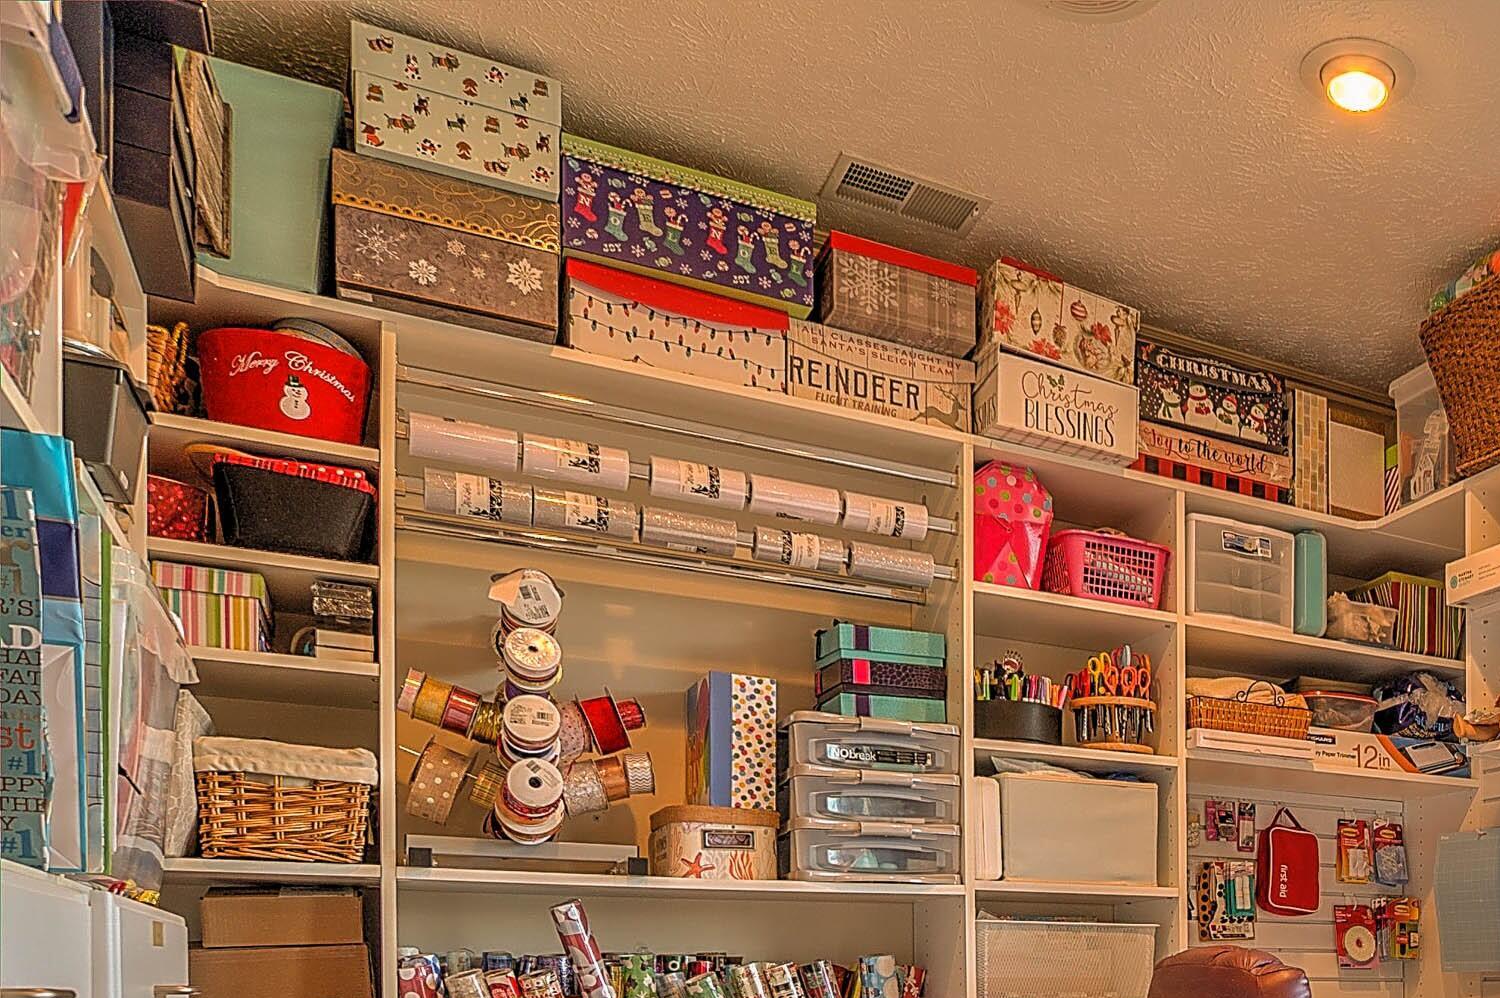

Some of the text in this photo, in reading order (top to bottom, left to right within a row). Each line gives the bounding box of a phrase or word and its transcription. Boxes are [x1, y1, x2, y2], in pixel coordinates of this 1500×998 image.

[628, 174, 650, 188] JOY
[602, 242, 623, 253] JOY
[732, 274, 751, 285] JOY
[802, 325, 824, 337] ALL
[830, 332, 889, 351] CLASSES
[893, 347, 943, 365] TAUGHT
[811, 337, 954, 377] SANTA'S SLEIGH TEAM
[229, 350, 355, 402] Merry Christmas
[789, 355, 920, 411] REINDEER
[1156, 354, 1272, 392] CHRISTMAS
[815, 391, 897, 418] FLIGHT TRAINING
[1021, 370, 1119, 420] Christmas
[1024, 398, 1115, 448] BLESSINGS
[1190, 438, 1223, 461] the
[1224, 453, 1269, 475] world
[830, 747, 877, 761] NObreak
[1279, 864, 1288, 898] first aid
